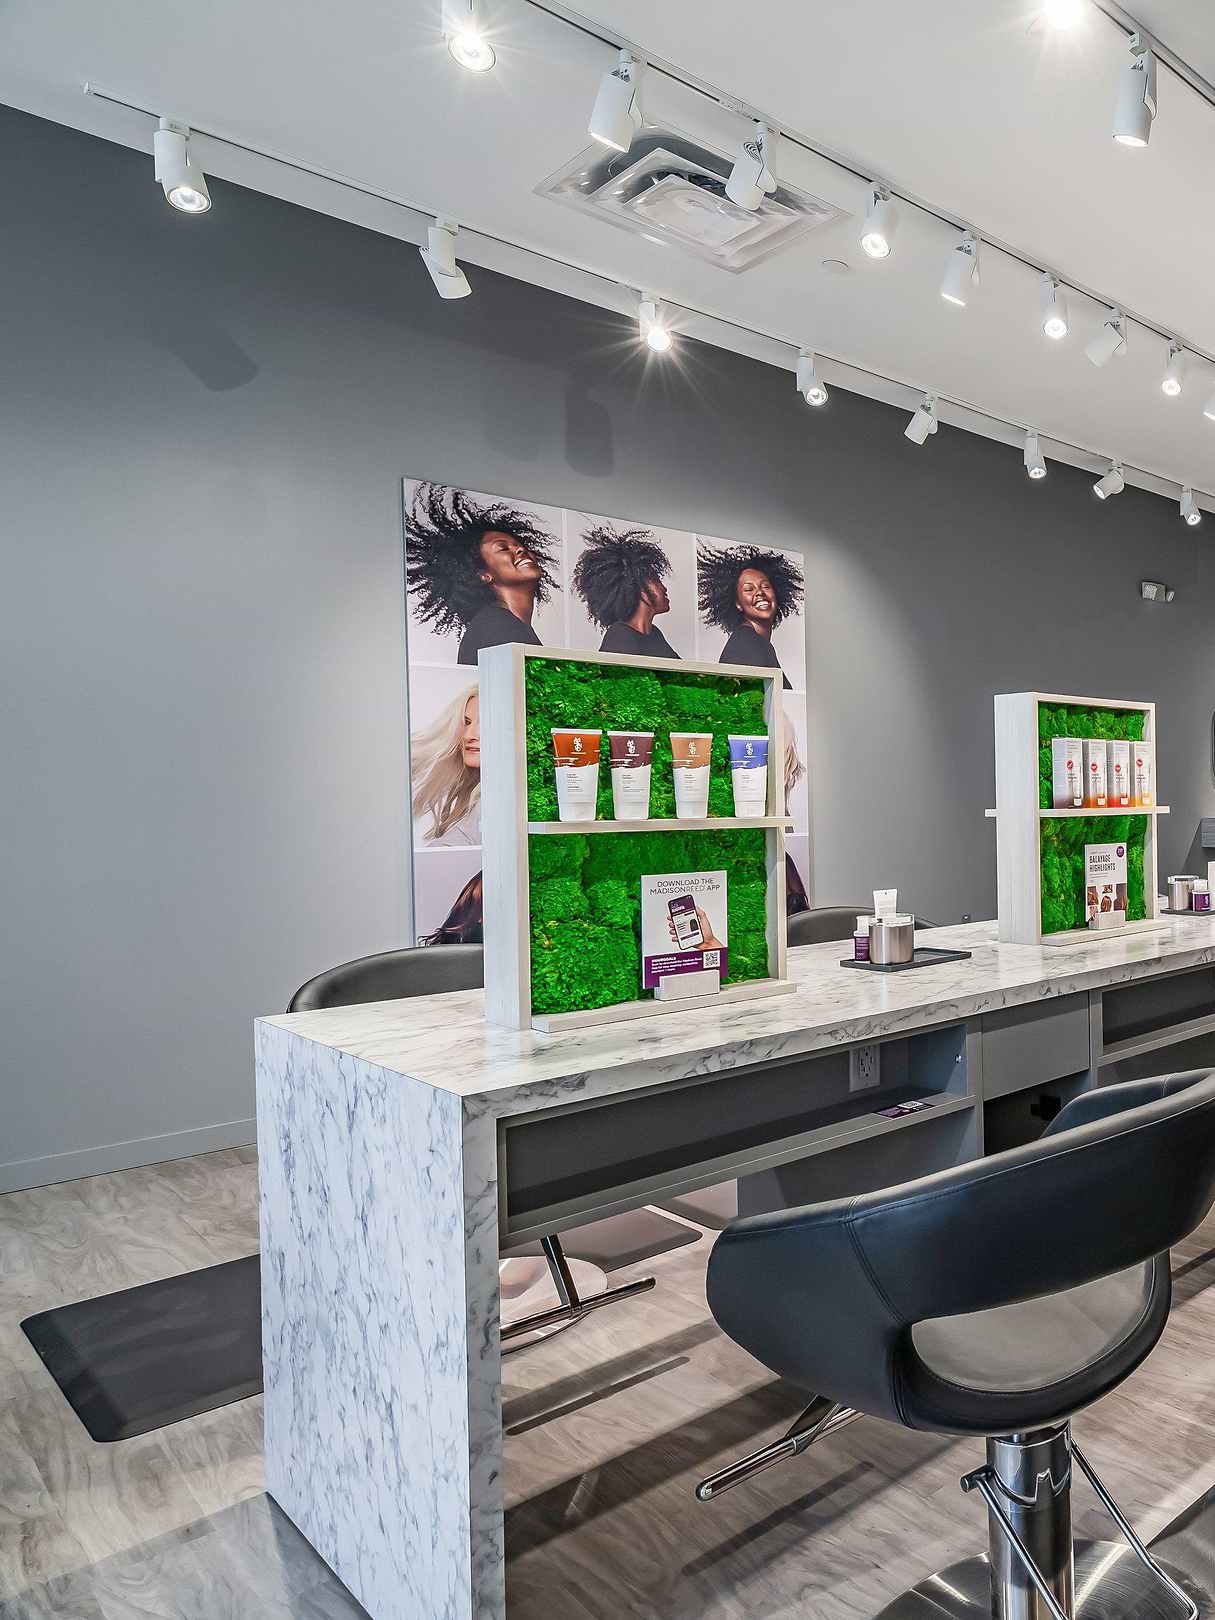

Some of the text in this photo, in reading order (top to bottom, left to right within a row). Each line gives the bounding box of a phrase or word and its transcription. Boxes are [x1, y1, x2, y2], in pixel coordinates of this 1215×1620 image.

[657, 877, 714, 888] DOWNLOAD THE
[706, 884, 721, 892] APP
